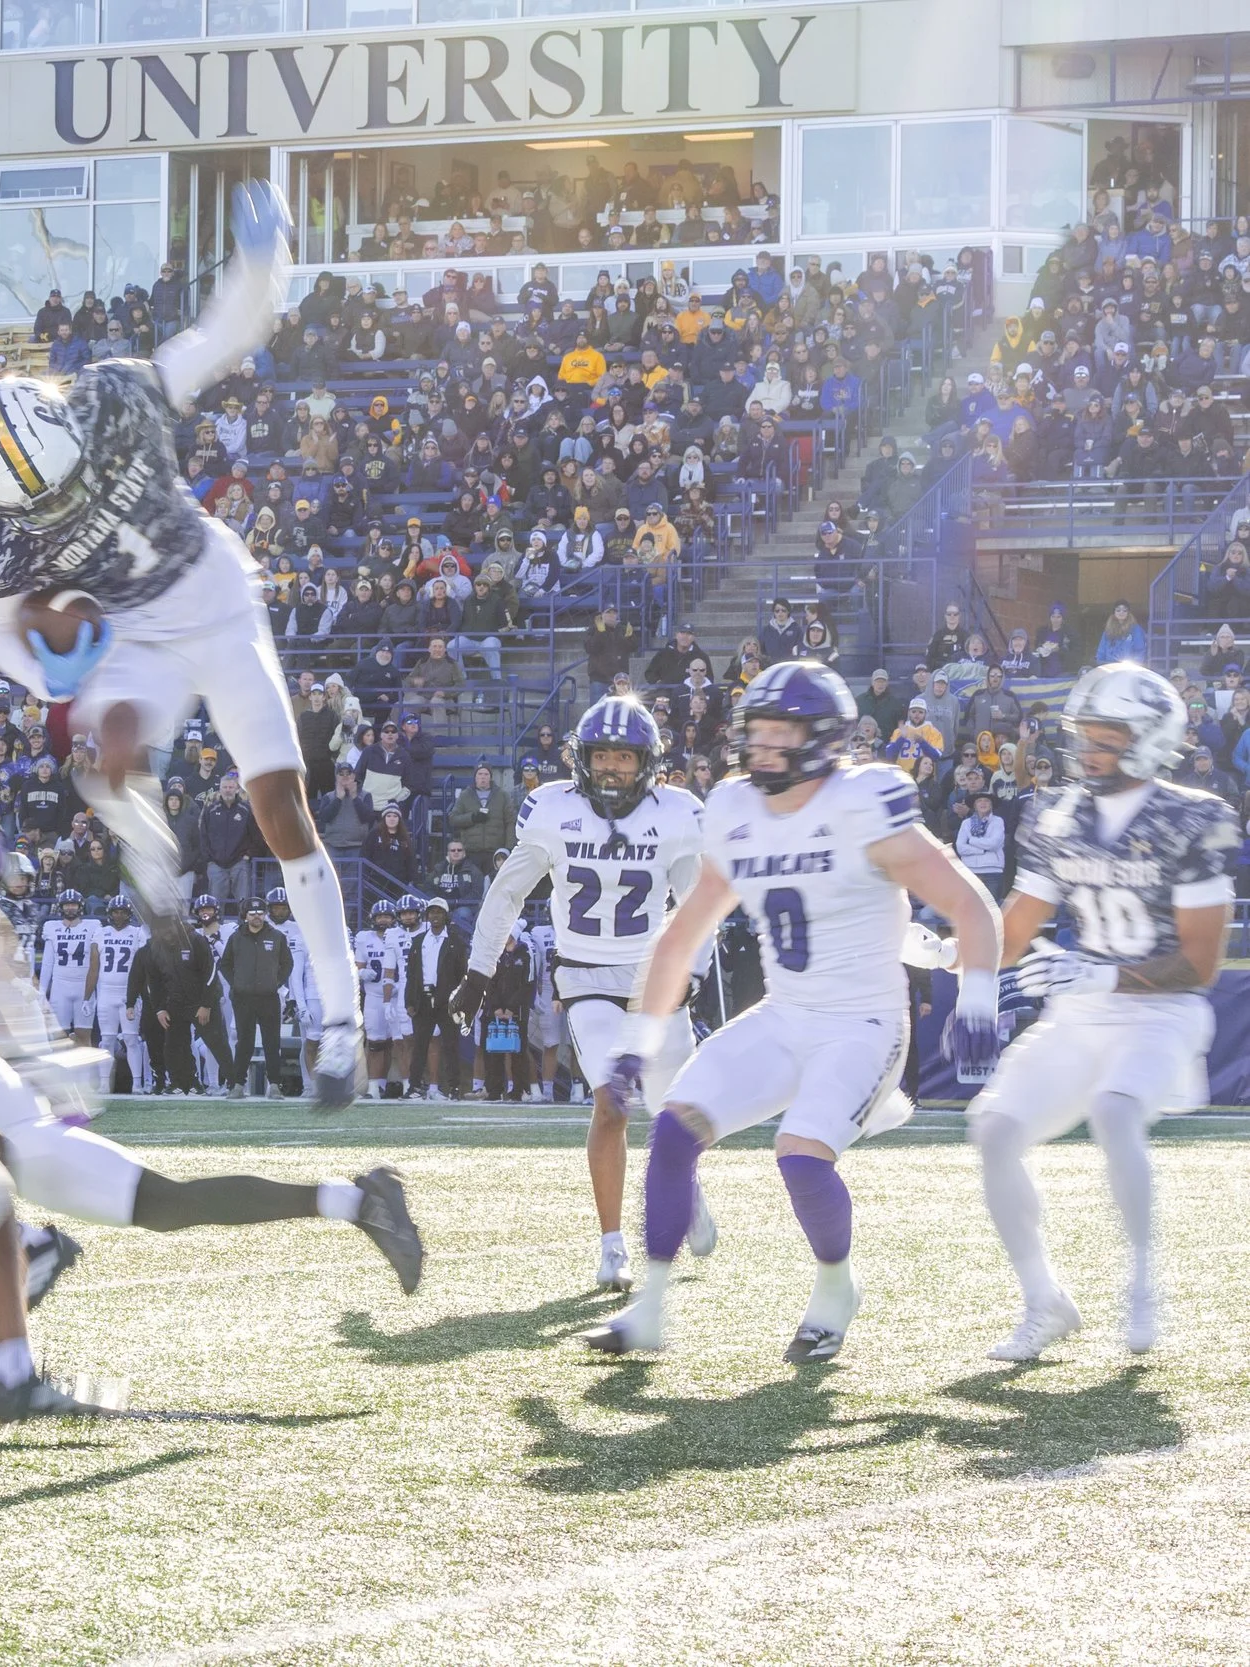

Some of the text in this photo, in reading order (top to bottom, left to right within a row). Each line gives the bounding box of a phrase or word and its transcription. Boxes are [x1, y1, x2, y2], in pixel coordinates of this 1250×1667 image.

[45, 13, 818, 146] UNIVERSITY
[565, 841, 659, 861] WILDCATS
[566, 864, 654, 937] 22
[1068, 883, 1157, 957] 10
[56, 941, 86, 966] 54
[763, 886, 810, 973] 0
[103, 946, 132, 972] 32
[960, 1066, 989, 1077] WEST
